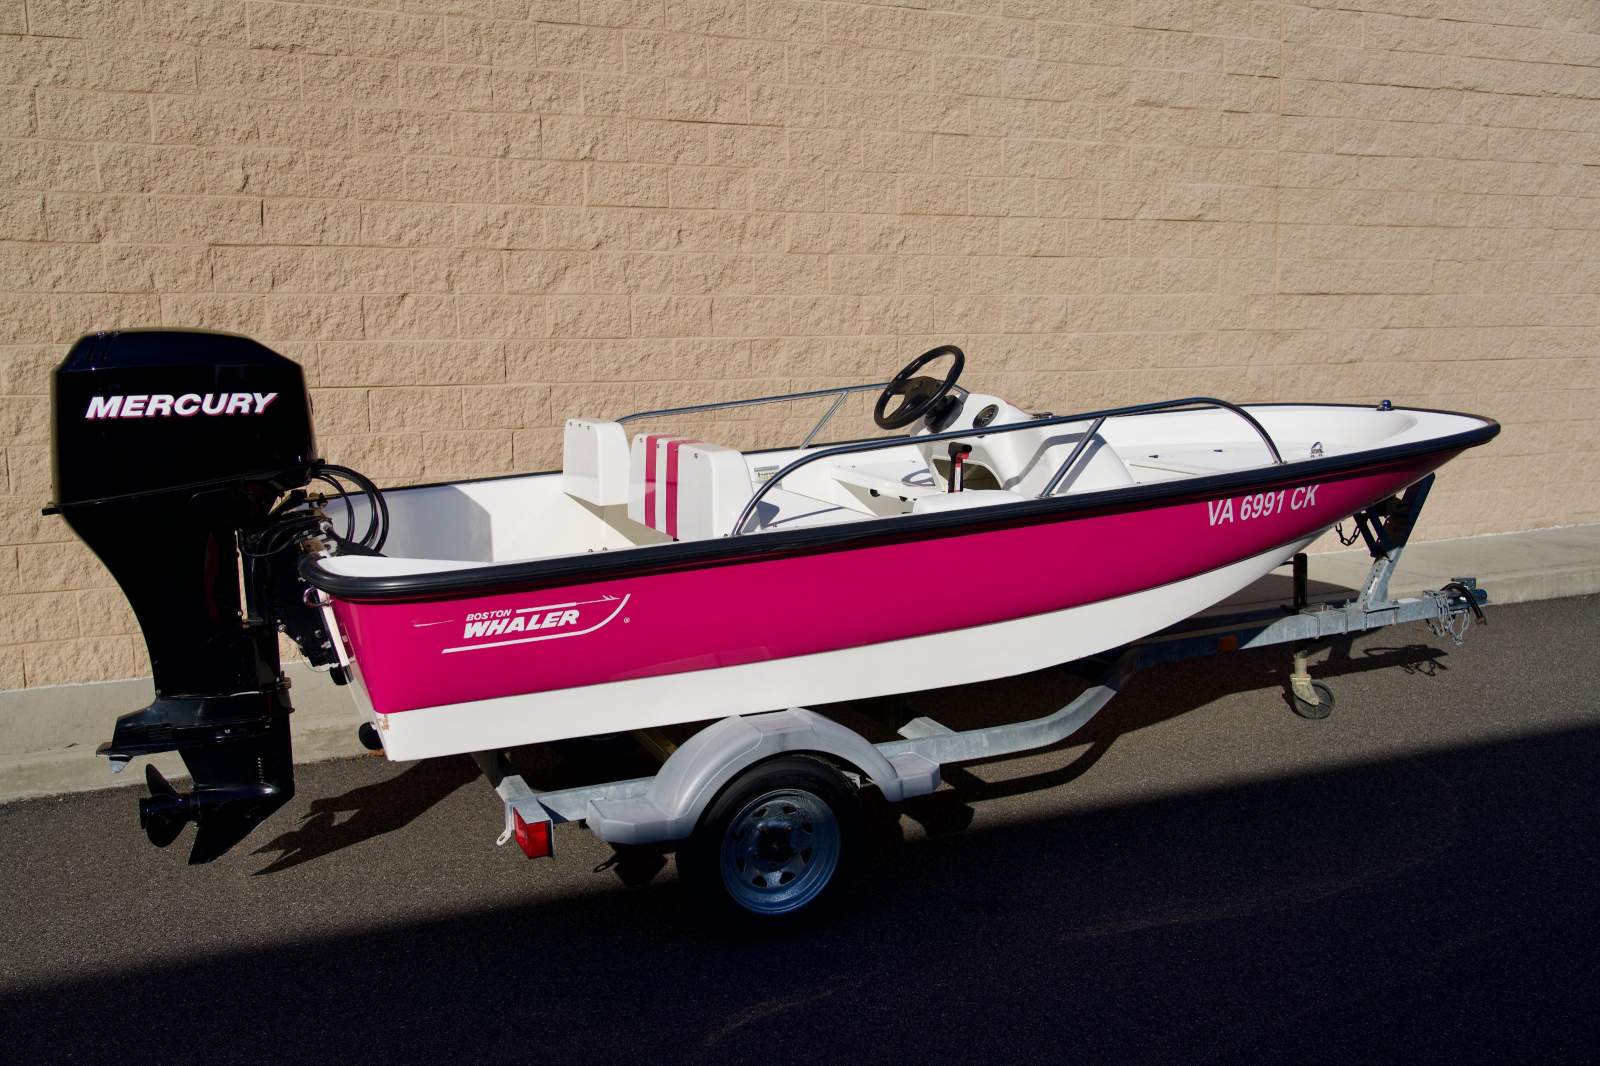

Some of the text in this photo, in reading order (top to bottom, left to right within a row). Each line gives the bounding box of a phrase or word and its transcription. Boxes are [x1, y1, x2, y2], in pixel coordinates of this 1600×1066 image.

[85, 392, 279, 420] MERCURY
[1207, 484, 1320, 526] VA 6991 CK
[463, 609, 580, 639] WHALER
[466, 608, 512, 622] BOSTON
